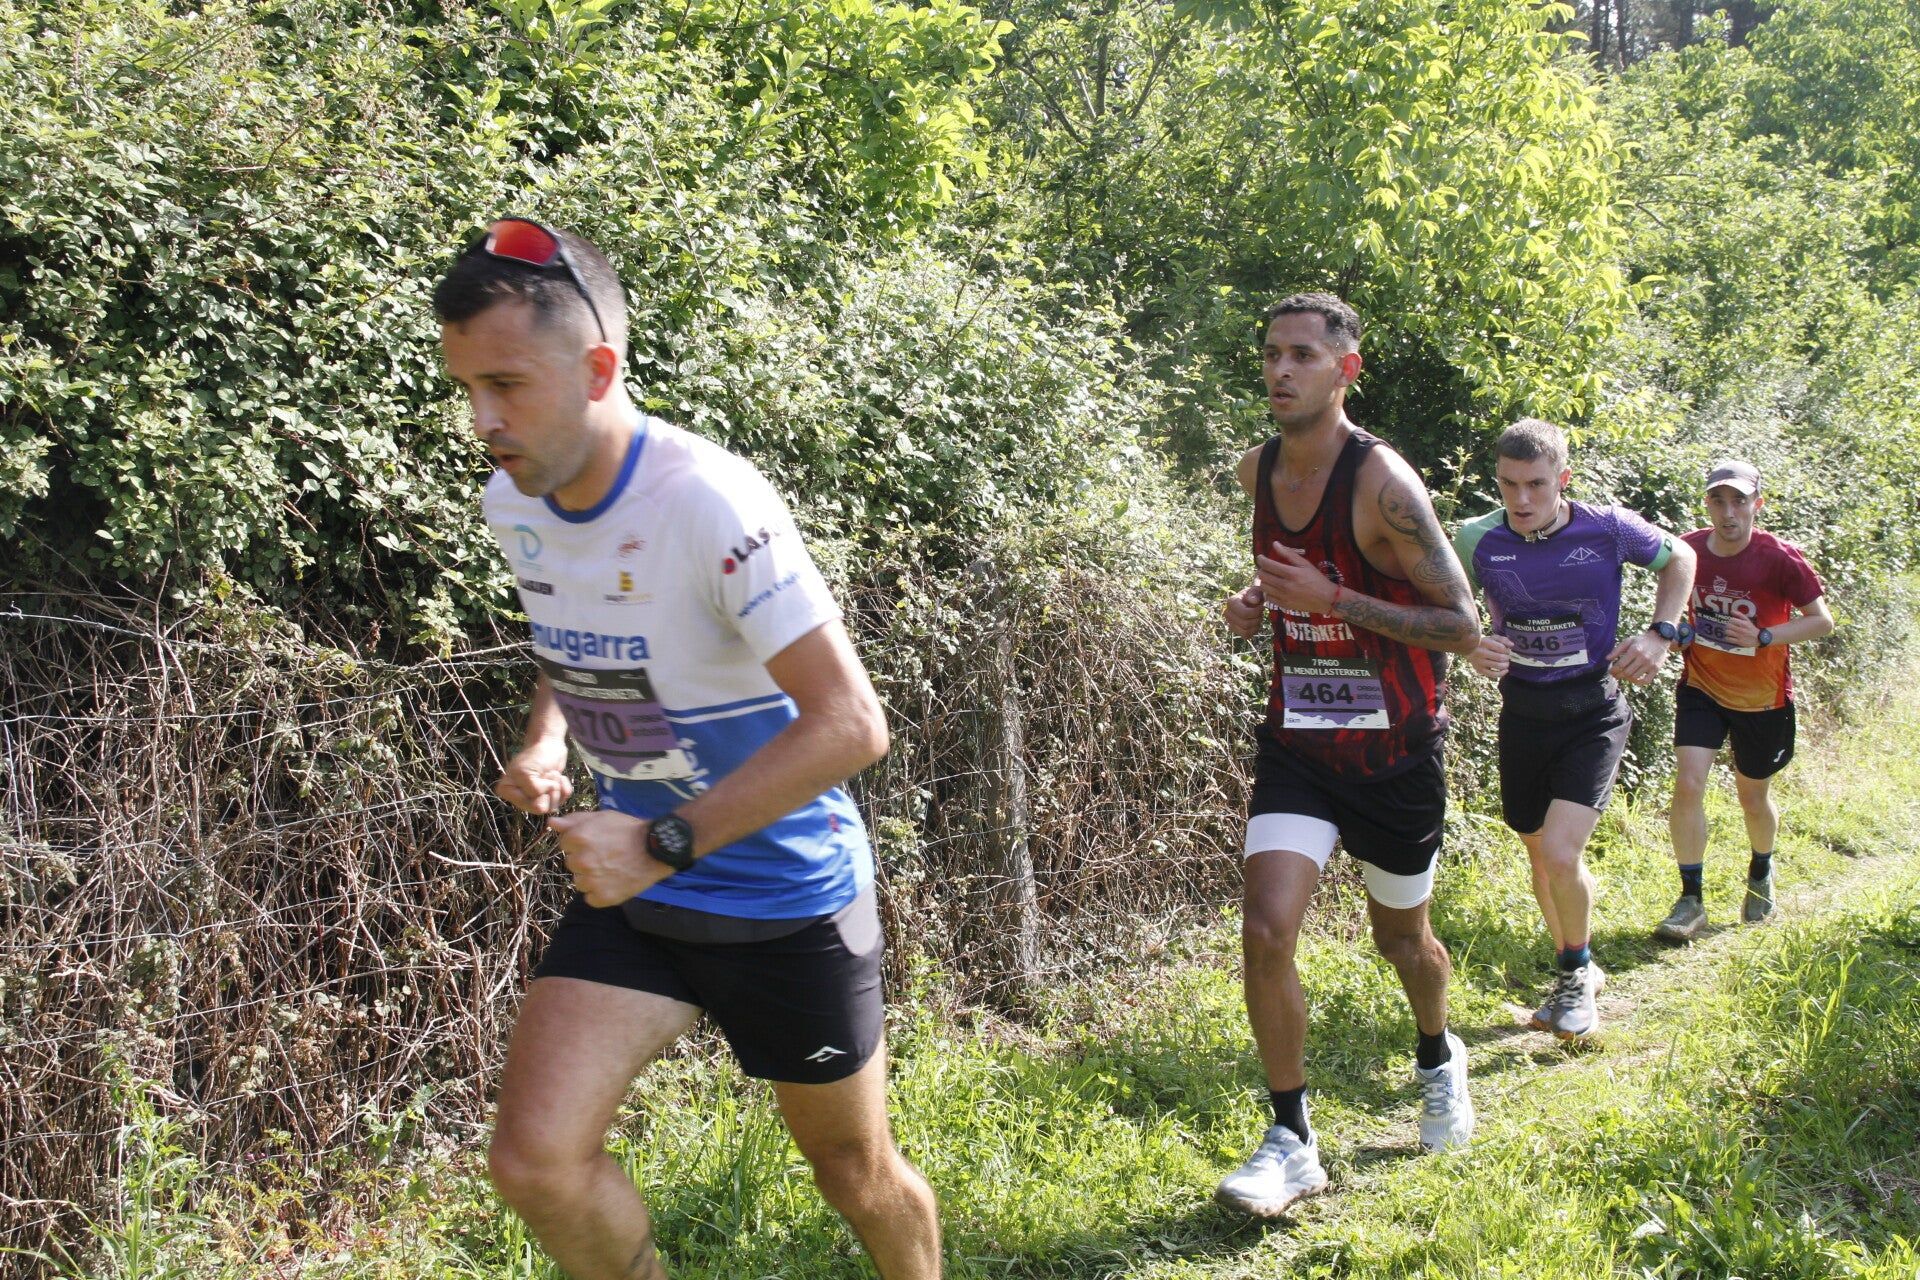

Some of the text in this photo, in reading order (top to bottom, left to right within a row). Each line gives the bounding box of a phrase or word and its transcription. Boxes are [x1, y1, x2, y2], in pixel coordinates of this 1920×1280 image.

[1533, 622, 1577, 632] LASTERKETA
[1517, 635, 1560, 651] 346
[1294, 667, 1318, 675] MENDI
[1320, 668, 1371, 677] LASTERKETA
[1299, 682, 1354, 705] 464
